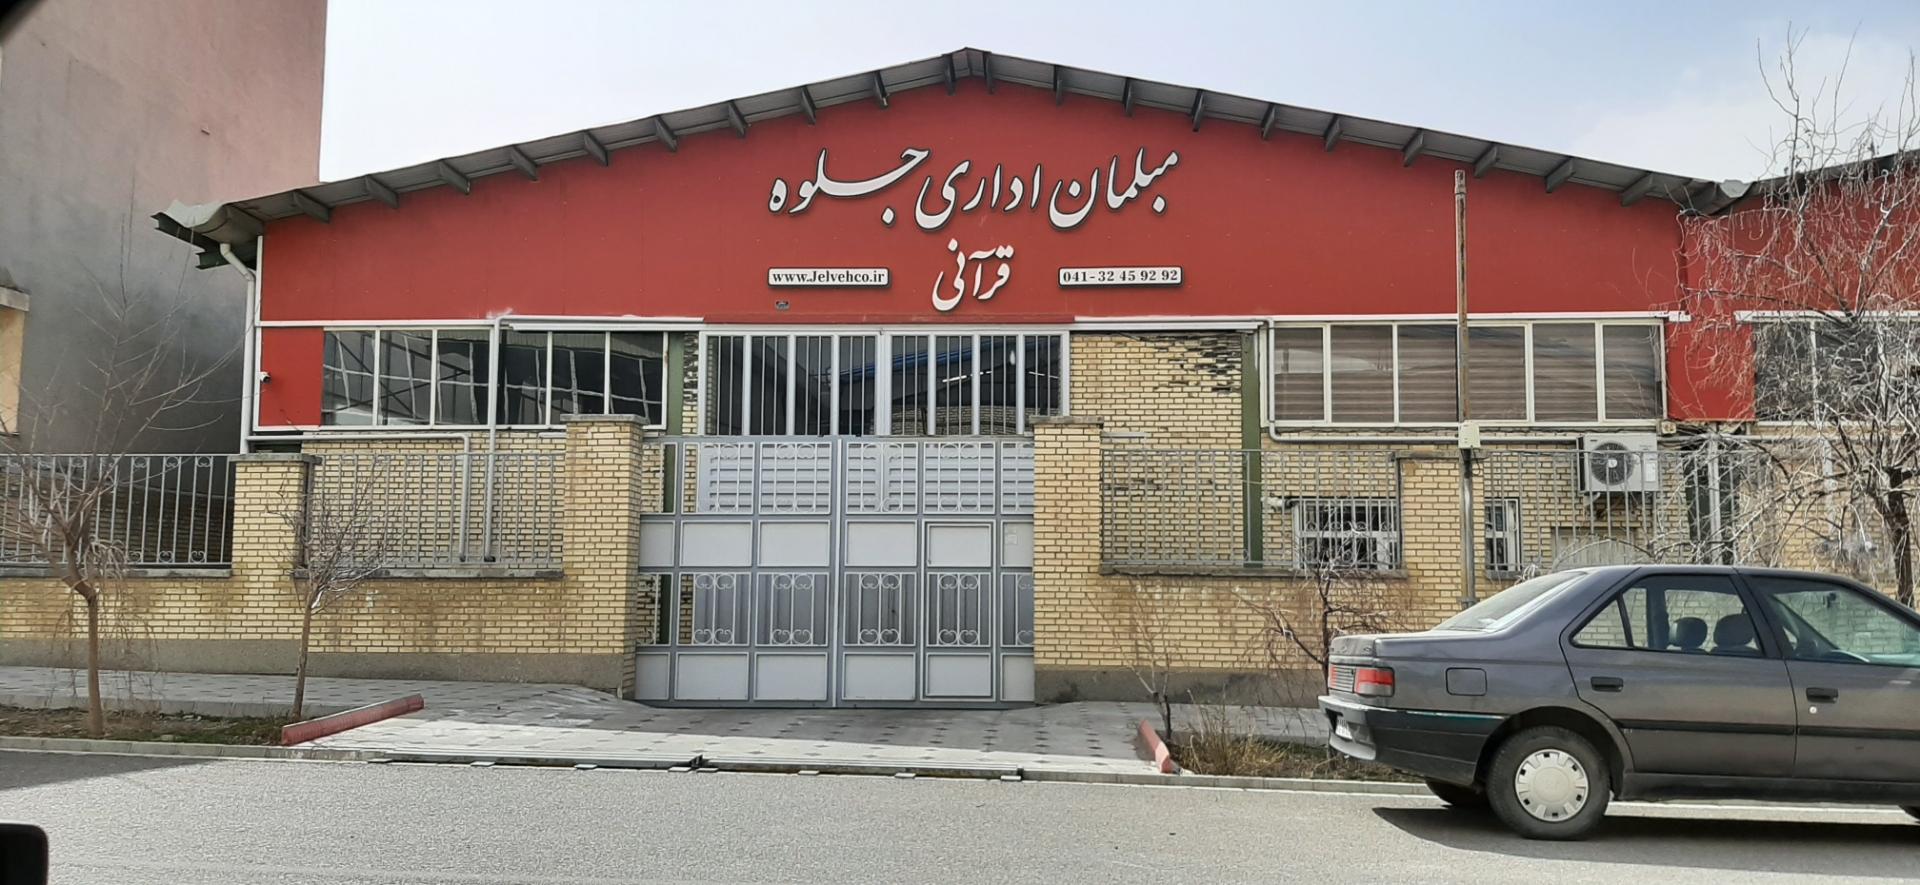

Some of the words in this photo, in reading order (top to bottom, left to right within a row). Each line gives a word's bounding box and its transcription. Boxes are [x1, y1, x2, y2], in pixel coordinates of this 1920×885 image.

[768, 147, 931, 227] جلوه
[914, 159, 1042, 230] اداری
[1048, 147, 1180, 229] مبلمان
[772, 270, 885, 283] www.Jelvehco.ir
[931, 238, 1015, 312] قرآنی
[1119, 270, 1136, 281] 45
[1140, 270, 1157, 281] 92
[1161, 269, 1178, 281] 92
